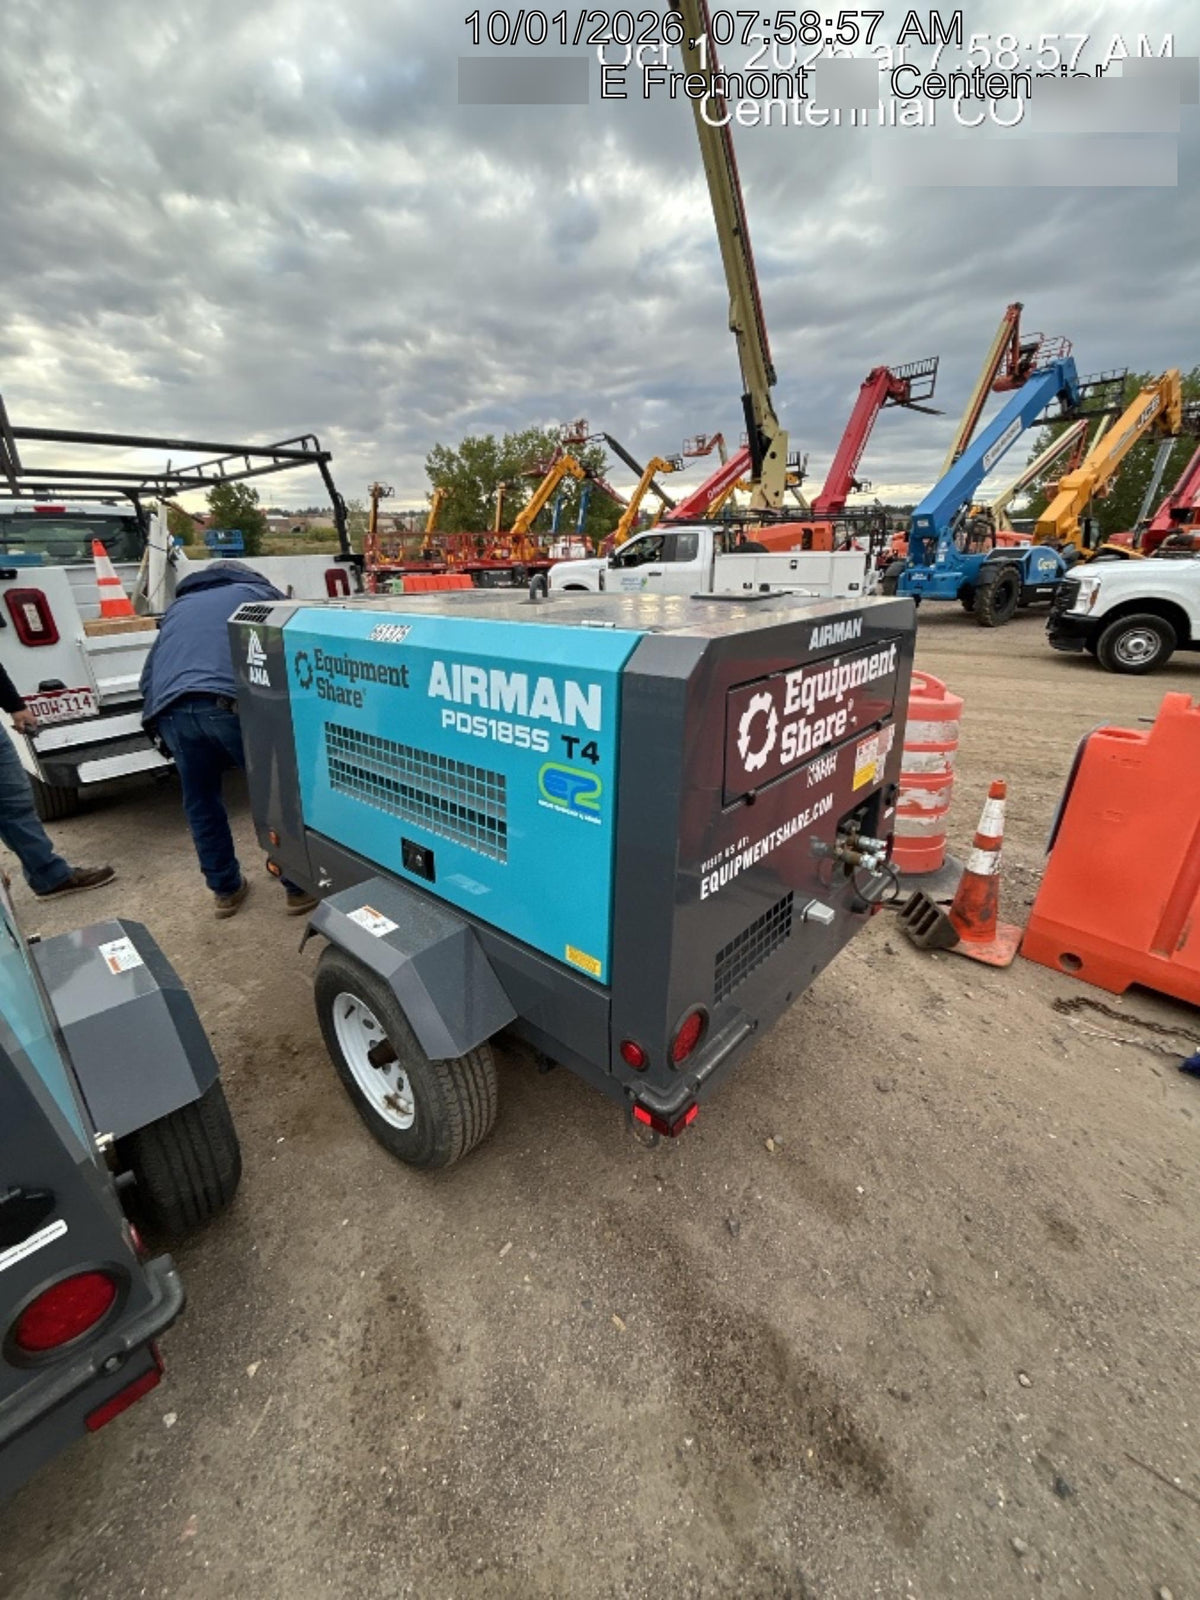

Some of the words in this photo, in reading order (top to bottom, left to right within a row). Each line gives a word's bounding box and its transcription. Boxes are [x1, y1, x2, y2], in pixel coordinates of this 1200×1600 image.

[809, 617, 864, 651] AIRMAN
[313, 648, 410, 689] Equipment
[428, 660, 602, 732] AIRMAN
[783, 643, 897, 716] Equipment
[441, 708, 550, 753] PDS185S
[561, 734, 600, 765] T4
[700, 792, 834, 900] EQUIPMENTSHARE.COM
